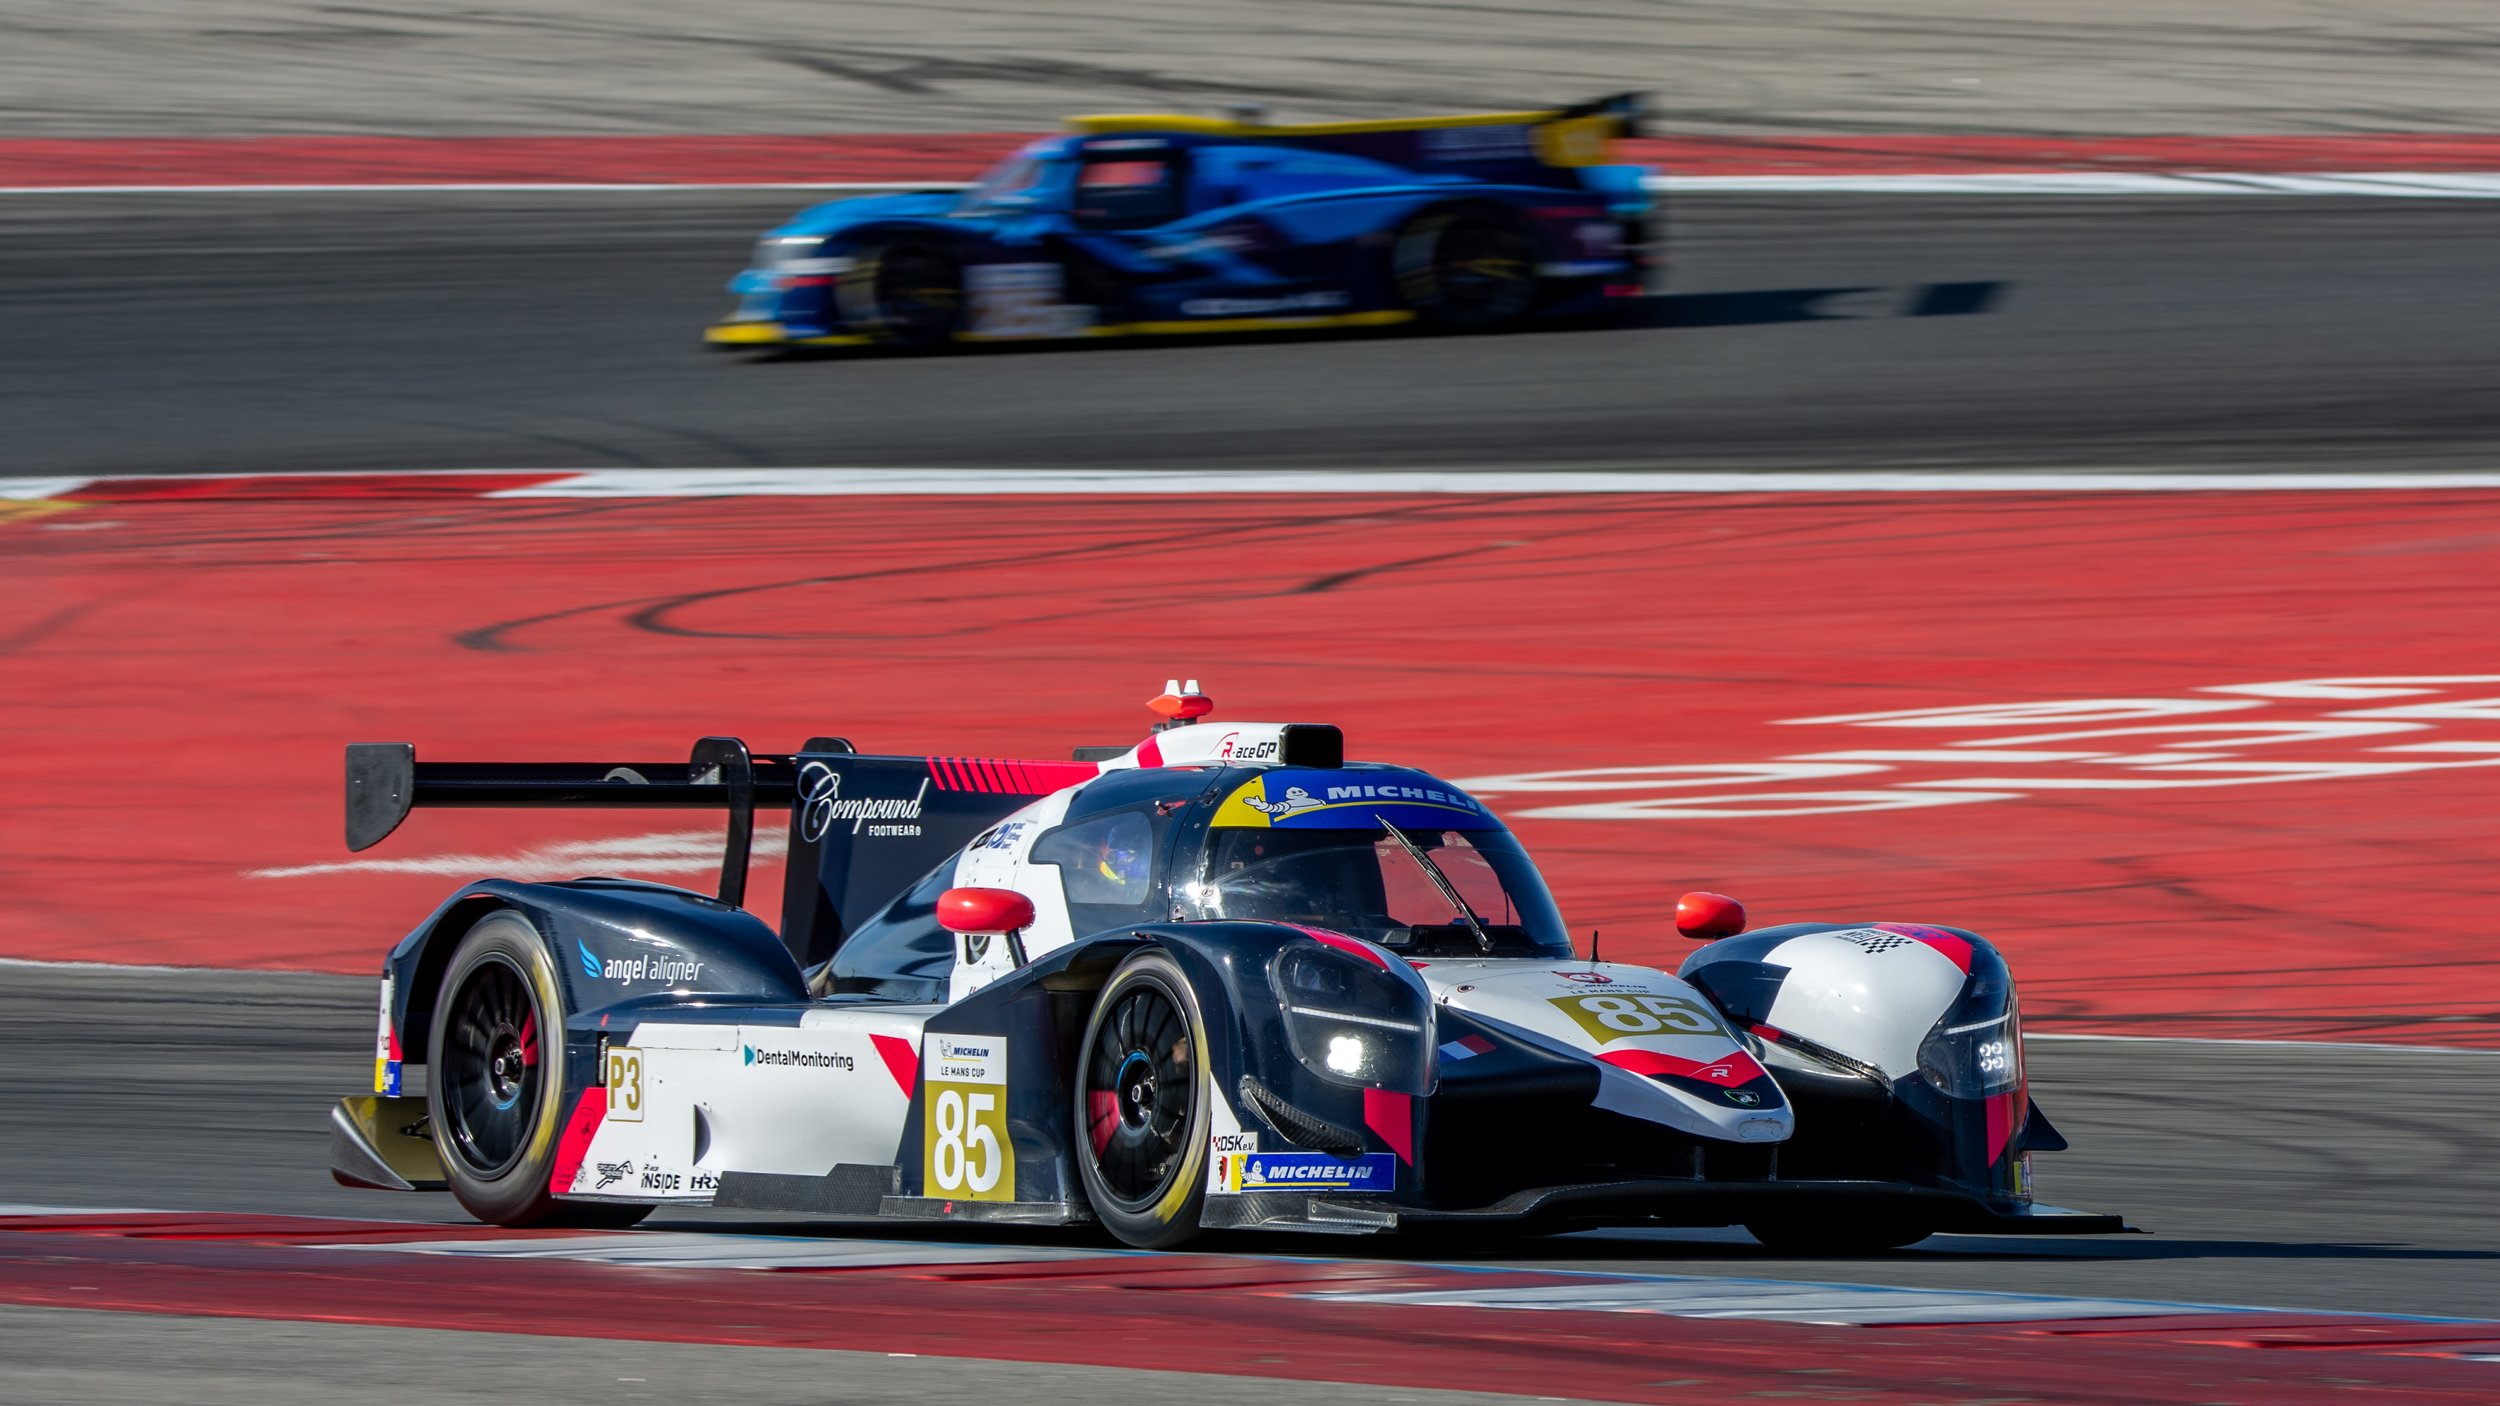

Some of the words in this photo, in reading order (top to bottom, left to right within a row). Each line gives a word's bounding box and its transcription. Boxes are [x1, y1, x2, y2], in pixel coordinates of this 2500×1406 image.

[797, 761, 930, 842] Compound
[604, 954, 649, 986] angel
[649, 955, 705, 987] aligner
[1579, 996, 1718, 1033] 85
[756, 1048, 854, 1072] DentalMonitoring
[952, 1046, 990, 1058] MICHELIN
[609, 1055, 641, 1111] P3
[940, 1066, 949, 1077] LE
[950, 1067, 970, 1078] MANS
[971, 1068, 986, 1078] CUP
[933, 1089, 1002, 1193] 85
[1220, 1135, 1244, 1152] DSK
[1268, 1165, 1373, 1180] MICHELIN
